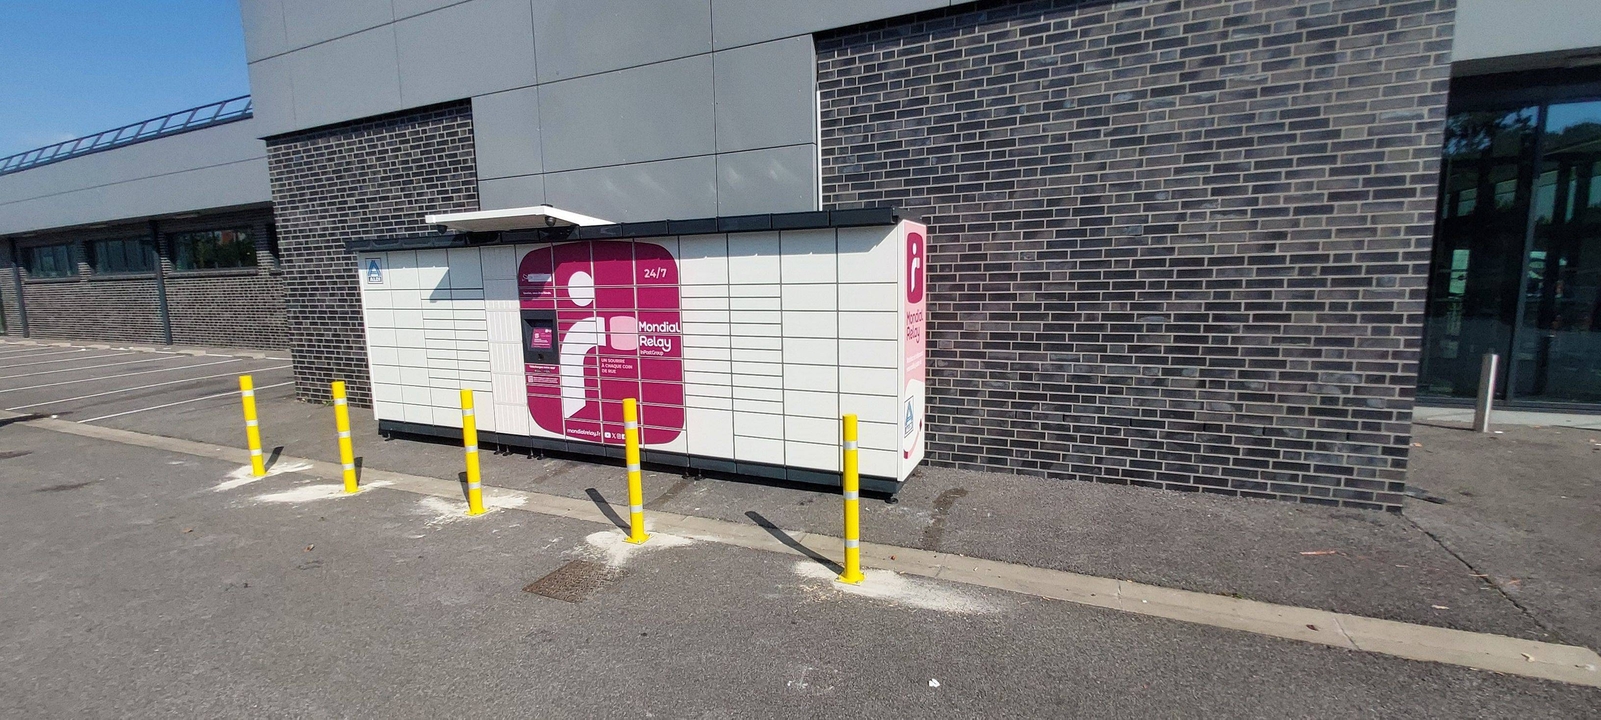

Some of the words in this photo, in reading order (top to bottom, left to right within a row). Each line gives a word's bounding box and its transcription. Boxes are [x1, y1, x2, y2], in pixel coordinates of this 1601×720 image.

[644, 267, 666, 278] 24/7
[639, 321, 681, 333] Mondial
[639, 336, 671, 352] Relay
